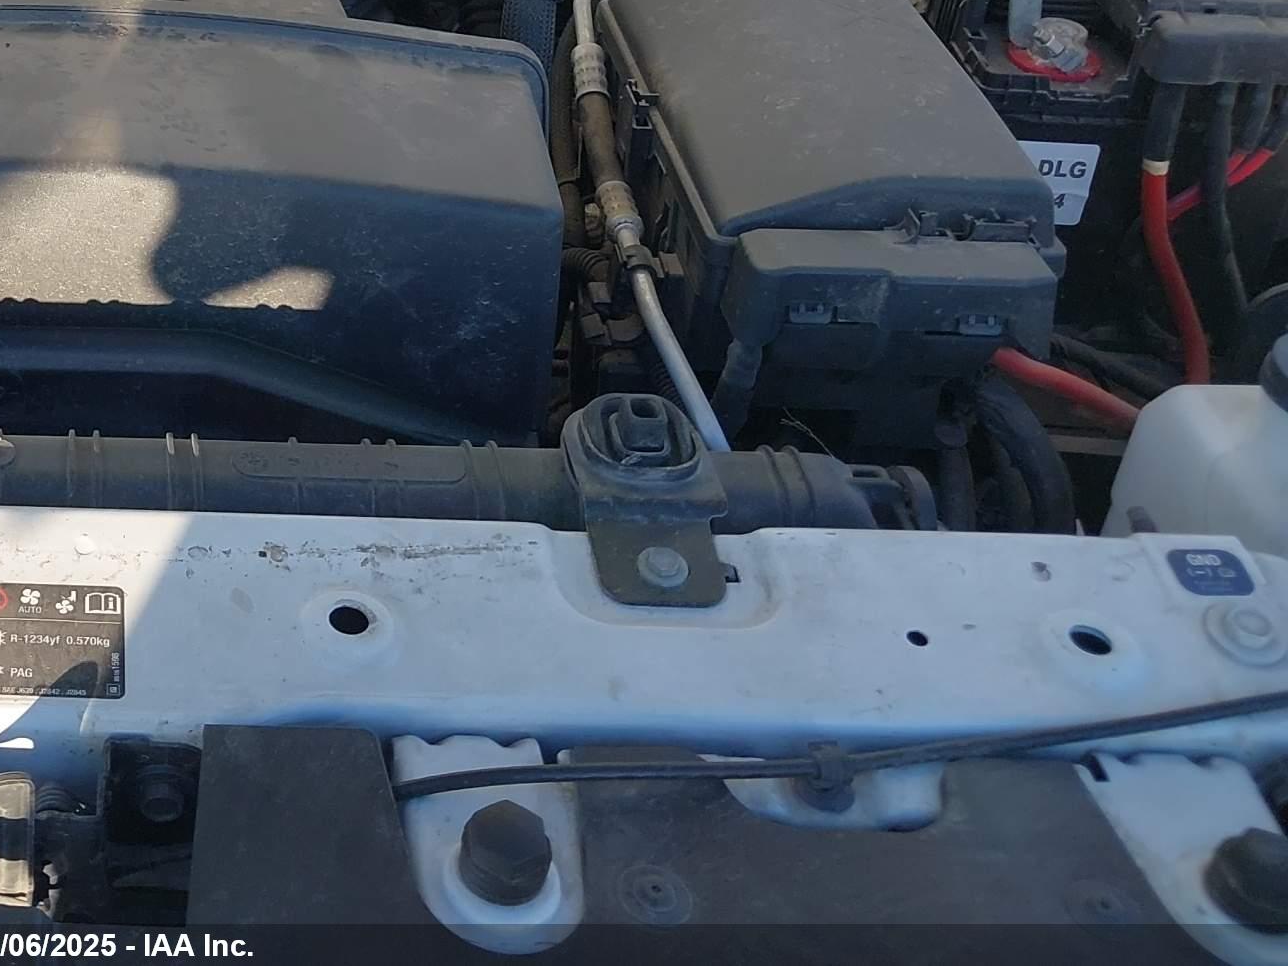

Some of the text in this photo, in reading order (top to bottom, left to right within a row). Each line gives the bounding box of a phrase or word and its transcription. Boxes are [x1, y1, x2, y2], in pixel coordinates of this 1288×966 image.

[1038, 159, 1088, 179] DLG
[18, 606, 42, 614] AUTO
[9, 634, 110, 648] R-1234yf 0.570kg
[10, 667, 33, 678] PAG
